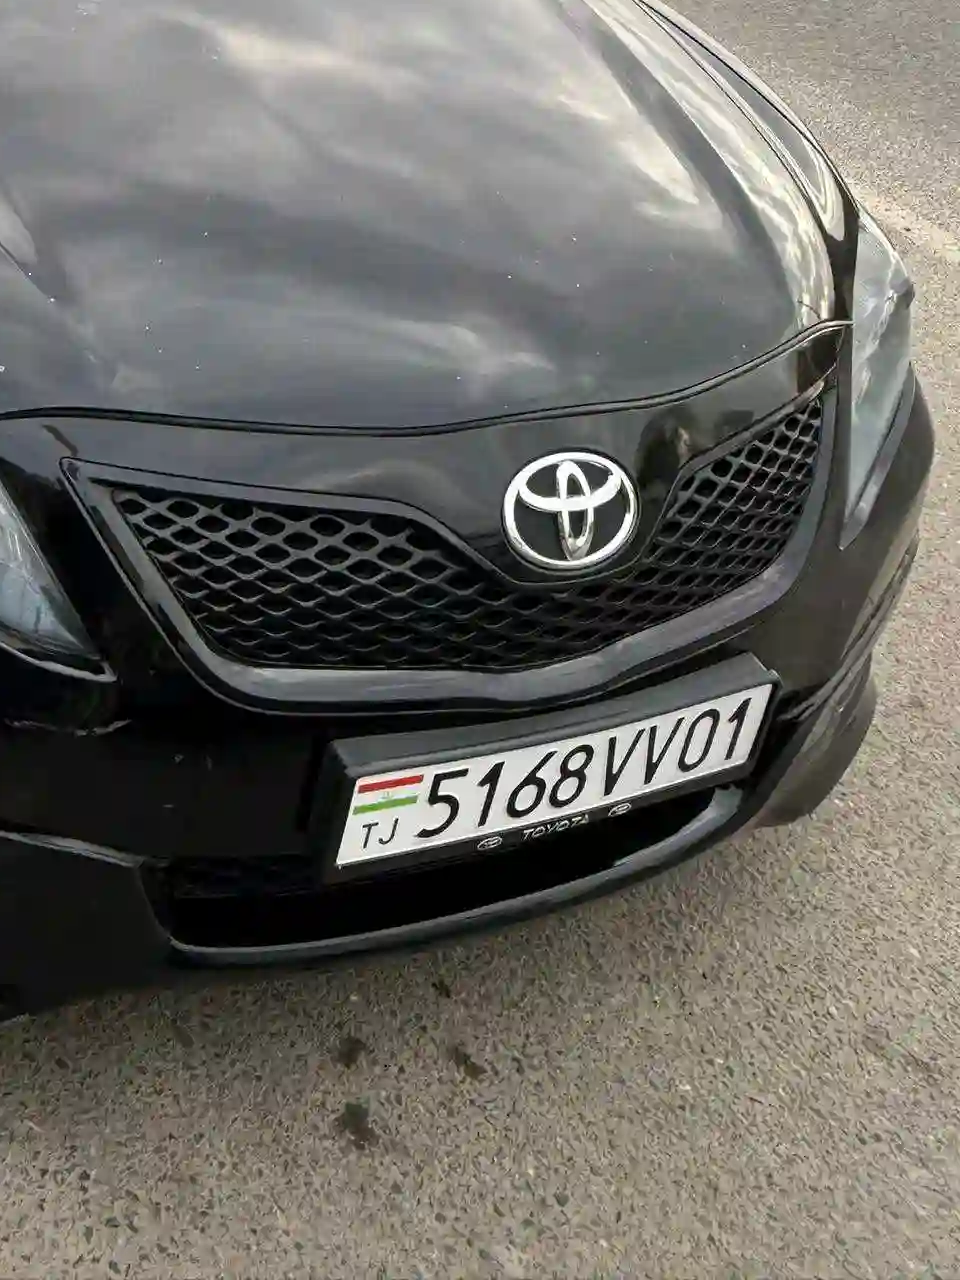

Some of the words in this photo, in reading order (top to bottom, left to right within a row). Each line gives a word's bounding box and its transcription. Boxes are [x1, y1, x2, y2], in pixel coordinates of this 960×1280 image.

[362, 817, 399, 849] TJ
[414, 697, 752, 839] 5168VV01
[522, 813, 589, 841] TOYOTA
